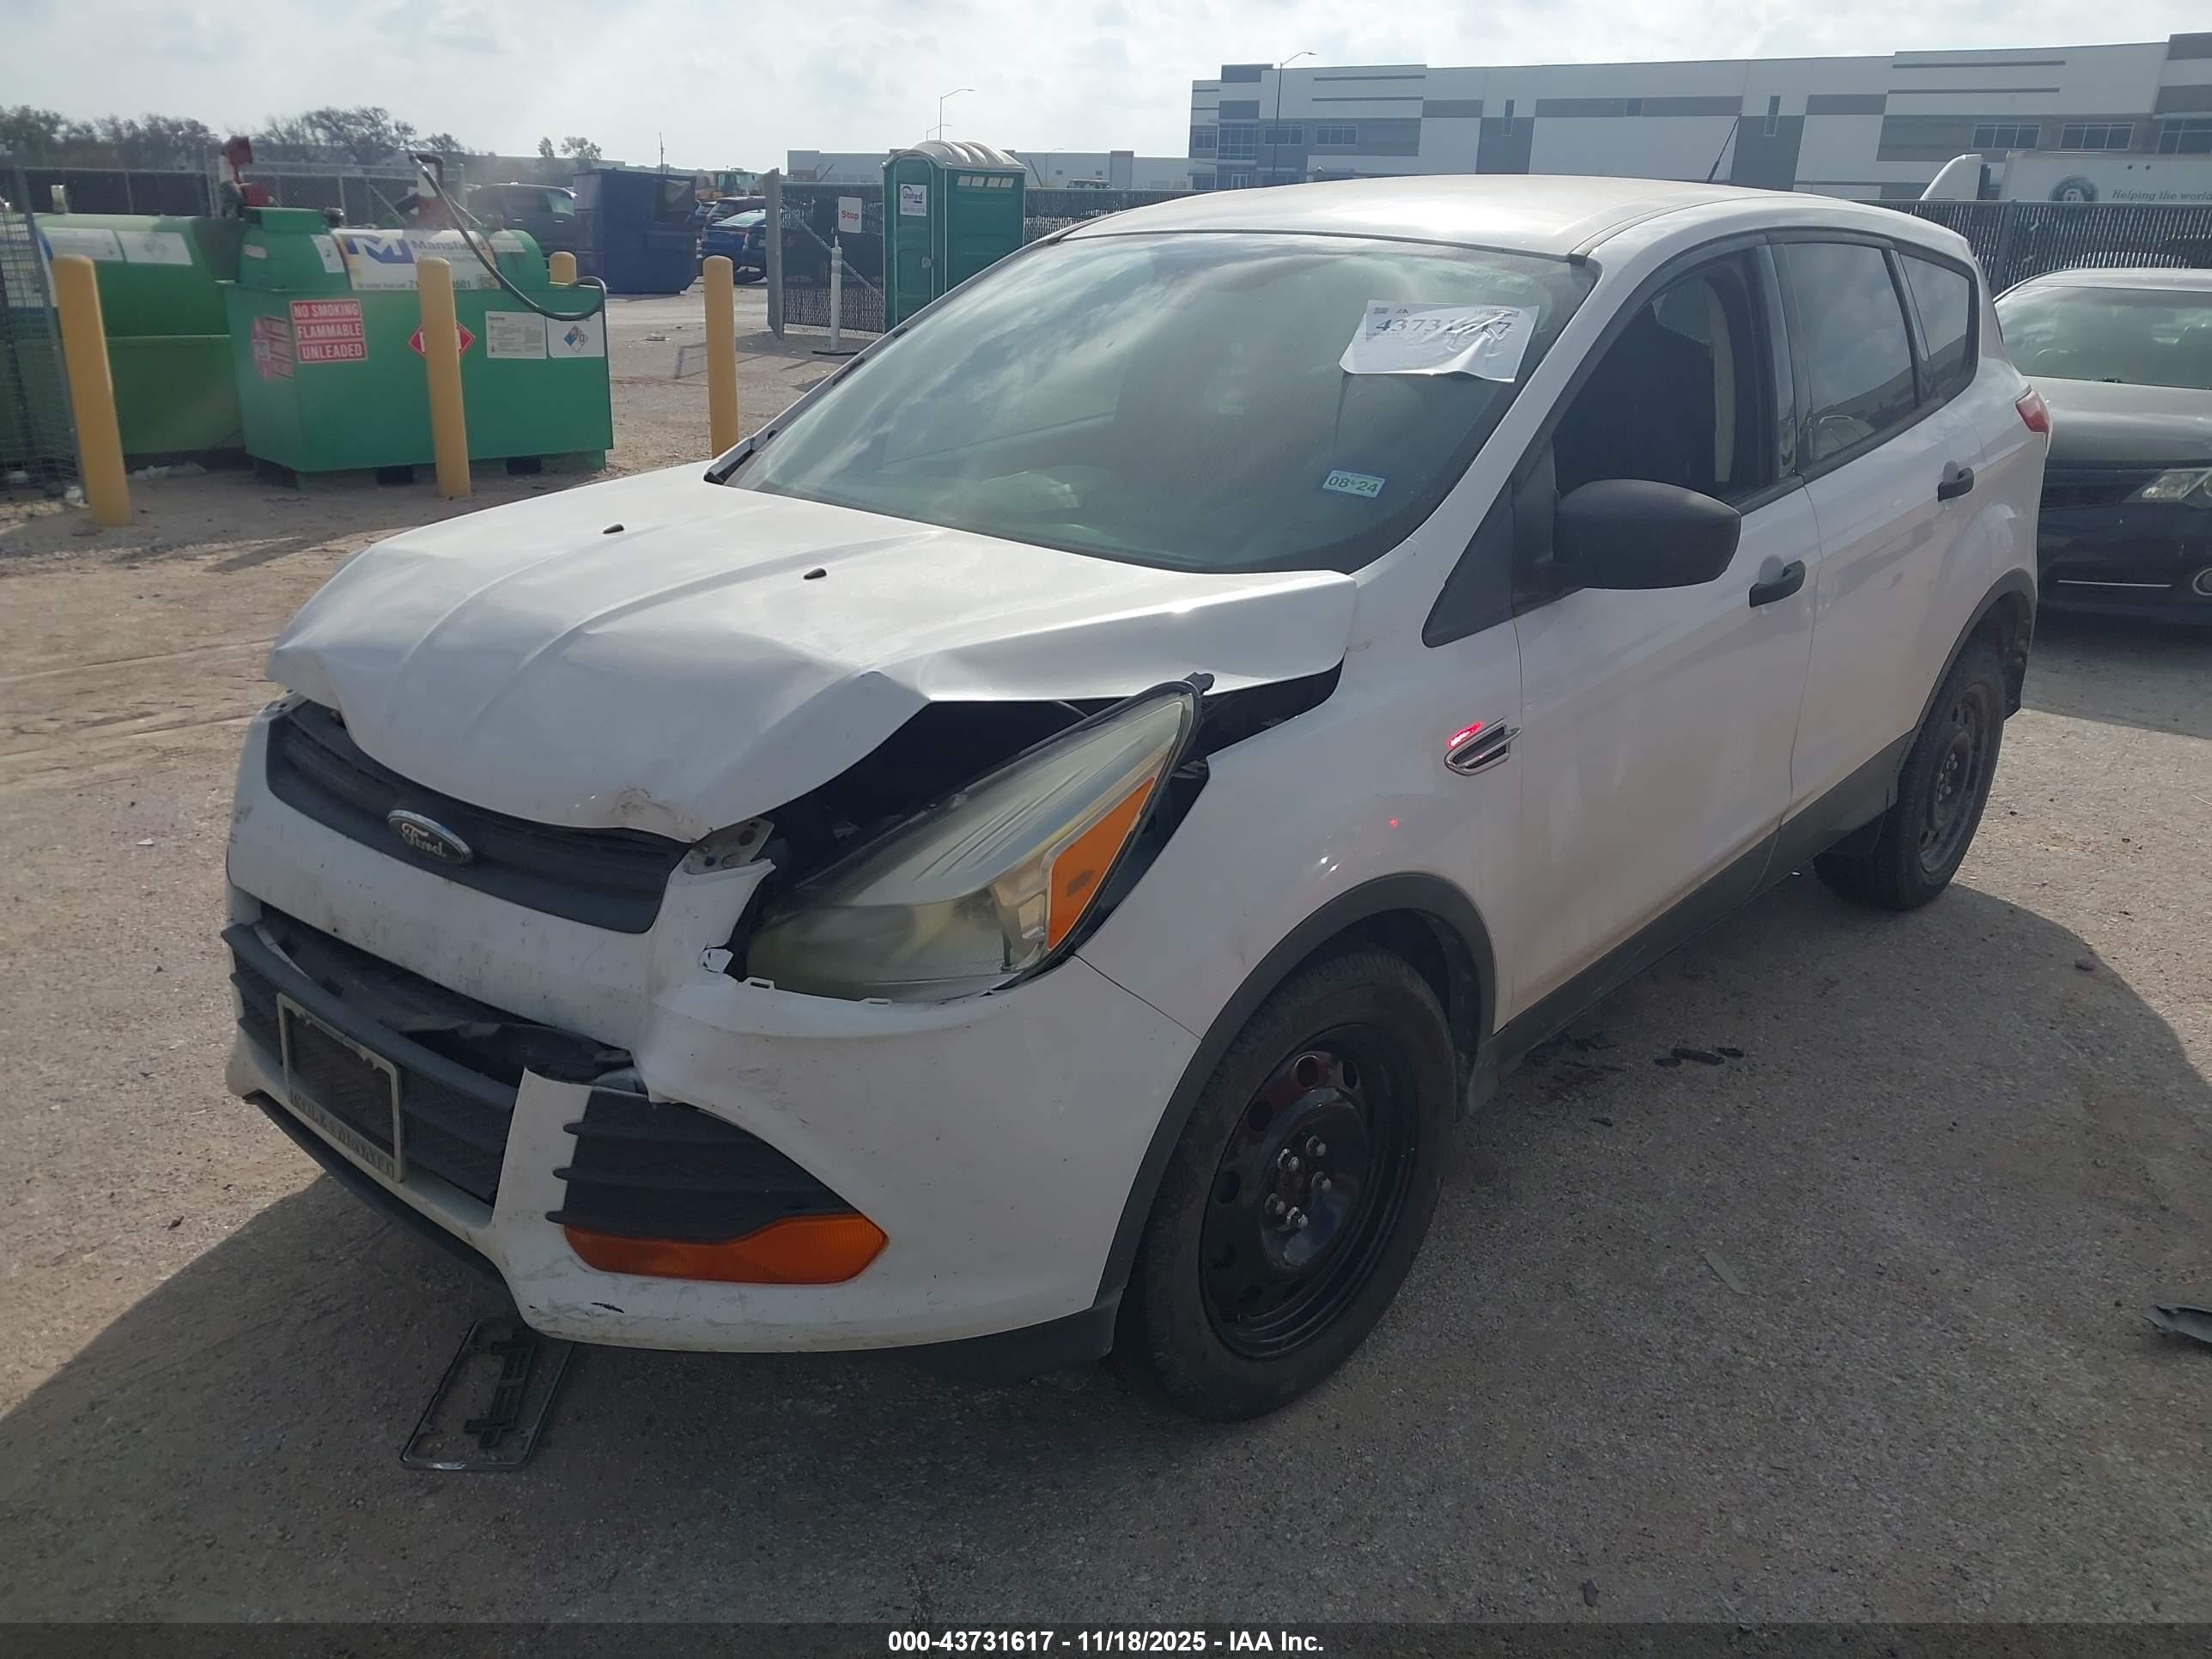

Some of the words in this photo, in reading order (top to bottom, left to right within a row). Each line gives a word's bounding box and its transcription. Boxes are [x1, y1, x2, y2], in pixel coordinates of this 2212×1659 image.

[2112, 189, 2156, 201] Helping
[2159, 191, 2177, 200] the
[842, 210, 860, 221] Stop
[293, 303, 310, 319] NO
[311, 302, 358, 318] SMOKING
[298, 323, 362, 339] FLAMMABLE
[301, 343, 363, 360] UNLEADED
[1328, 476, 1350, 488] 08
[1355, 481, 1379, 493] 24
[401, 823, 447, 858] Ford
